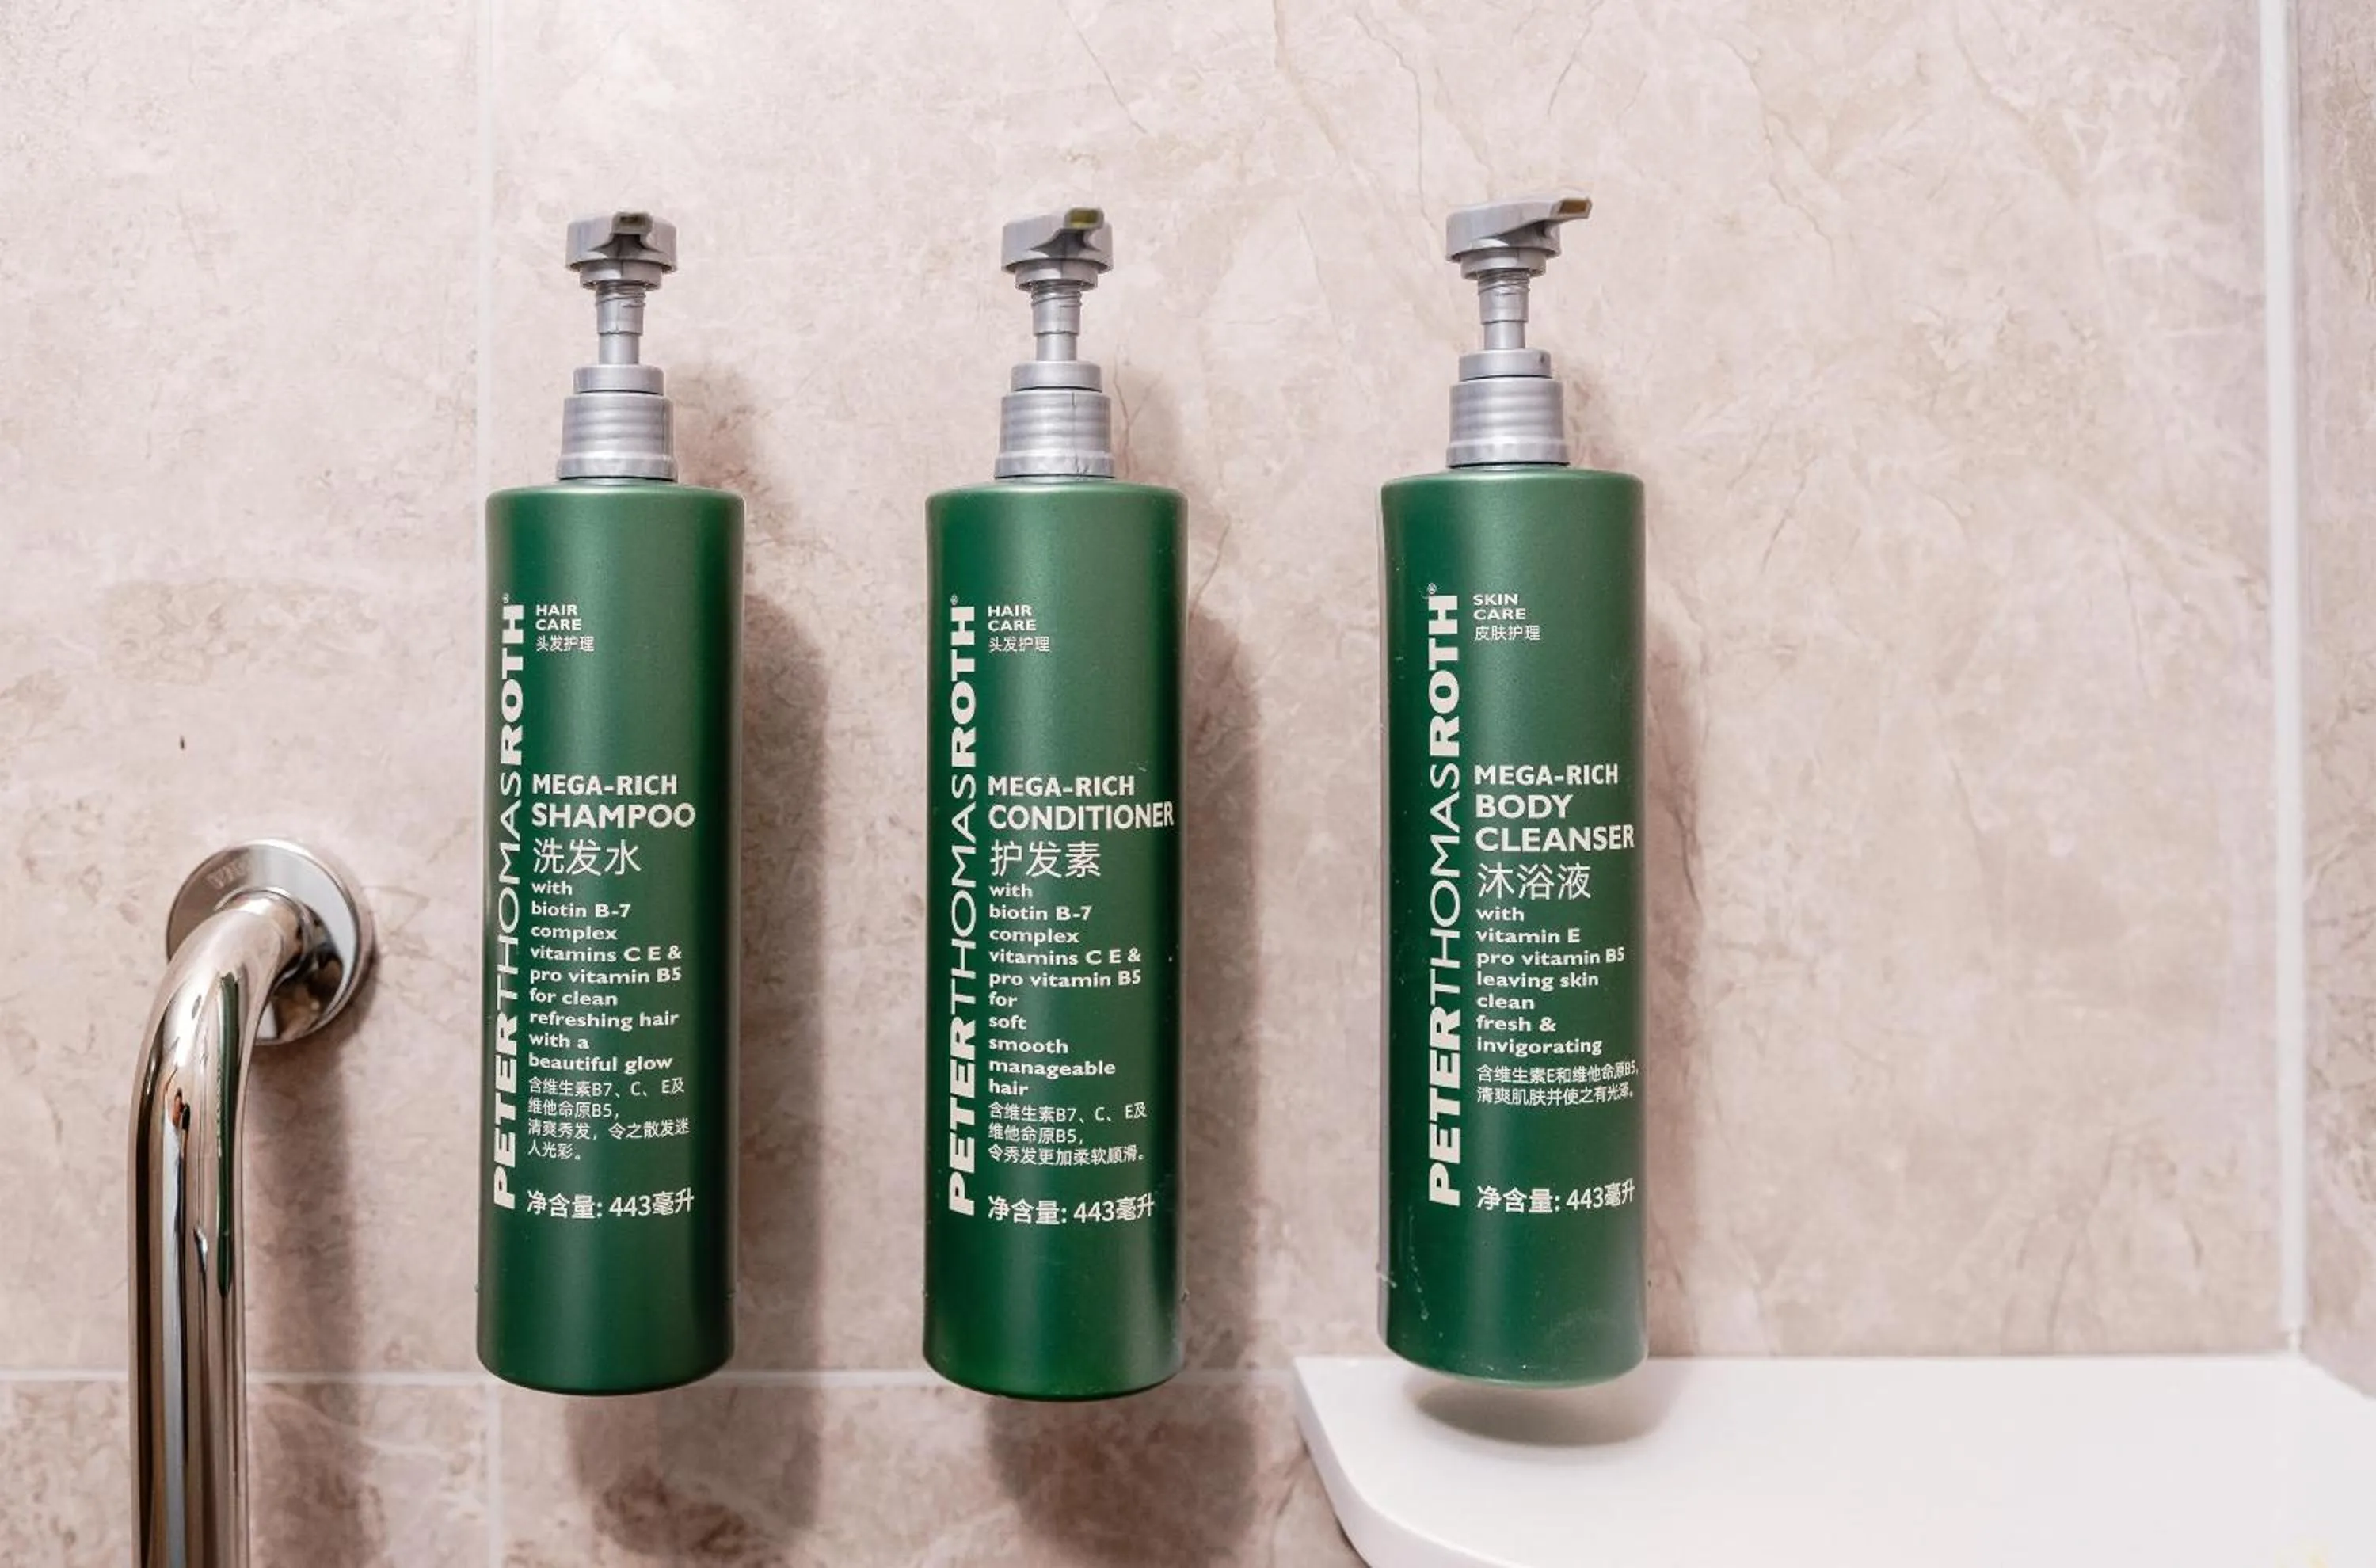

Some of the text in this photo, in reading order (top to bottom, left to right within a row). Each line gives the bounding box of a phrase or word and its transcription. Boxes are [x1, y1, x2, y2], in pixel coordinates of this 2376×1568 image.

[1473, 594, 1517, 605] SKIN
[536, 604, 577, 616] HAIR
[988, 605, 1032, 616] HAIR
[1474, 607, 1525, 620] CARE
[536, 618, 581, 630] CARE
[988, 619, 1037, 631] CARE
[1475, 624, 1540, 641] 皮肤护理
[537, 635, 594, 652] 头发护理
[990, 636, 1050, 652] 头发护理
[1475, 763, 1618, 786] MEGA-RICH
[533, 774, 676, 795] MEGA-RICH
[988, 775, 1134, 797] MEGA-RICH
[1476, 794, 1573, 818] BODY
[532, 802, 695, 828] SHAMPOO
[988, 801, 1173, 830] CONDITIONER
[1475, 824, 1634, 851] CLEANSER
[534, 838, 641, 876] 洗发水
[990, 839, 1101, 877] 护发素
[532, 881, 572, 895] with
[1478, 862, 1590, 900] 沐浴液
[990, 883, 1033, 898] with
[532, 901, 630, 918] biotin B-7
[990, 904, 1092, 921] biotin B-7
[1476, 906, 1524, 921] with
[531, 926, 618, 943] complex
[990, 928, 1079, 947] complex
[1476, 927, 1581, 943] vitamin E
[531, 945, 681, 961] vitamins C E &
[989, 947, 1141, 965] vitamins C E &
[1477, 946, 1624, 968] pro vitamin B5
[531, 966, 682, 984] pro vitamin B5
[989, 969, 1141, 988] pro vitamin B5
[1477, 971, 1598, 991] leaving skin
[530, 988, 618, 1006] for clean
[989, 991, 1017, 1007] for
[1477, 993, 1535, 1009] clean
[531, 1010, 680, 1032] refreshing hair
[989, 1015, 1026, 1030] soft
[1476, 1014, 1556, 1032] fresh &
[529, 1033, 589, 1049] with a
[989, 1039, 1068, 1053] smooth
[1478, 1036, 1602, 1057] invigorating
[529, 1052, 673, 1075] beautiful glow
[989, 1060, 1115, 1079] manageable
[989, 1079, 1029, 1096] hair
